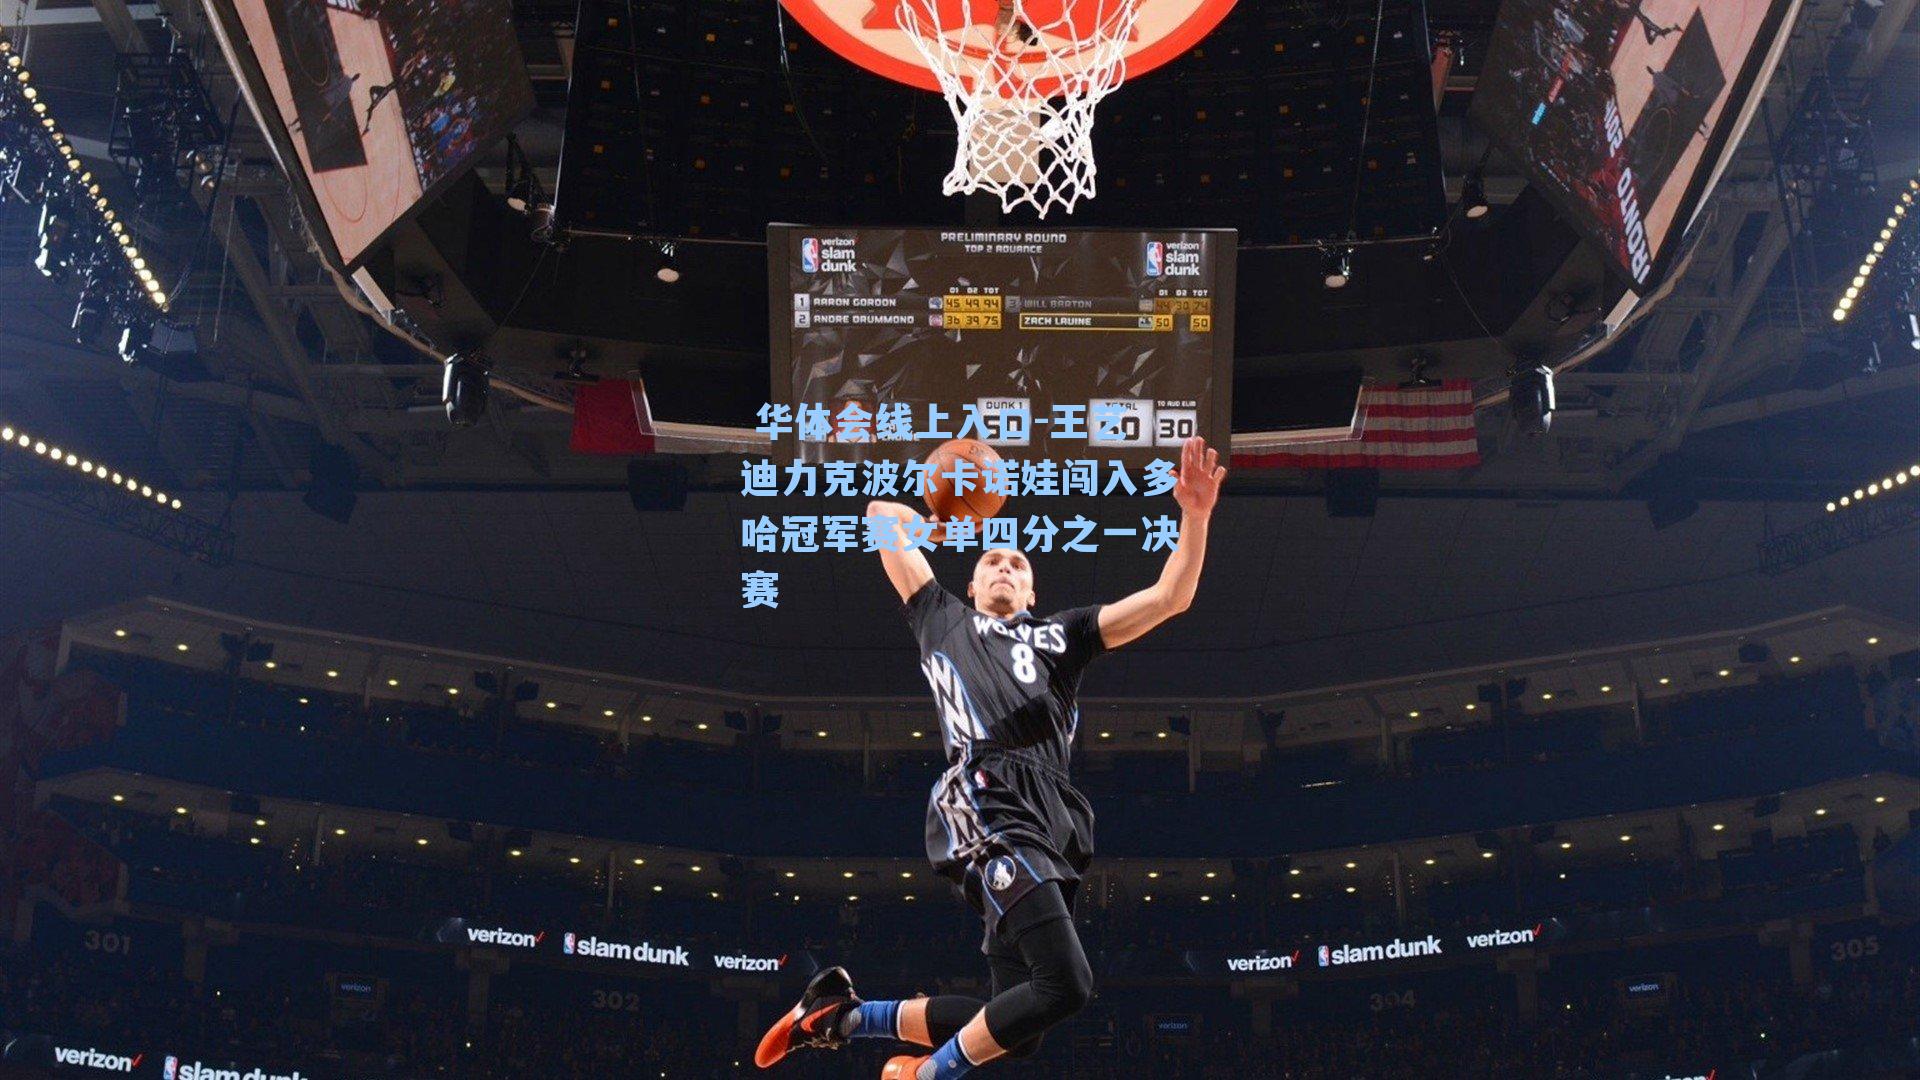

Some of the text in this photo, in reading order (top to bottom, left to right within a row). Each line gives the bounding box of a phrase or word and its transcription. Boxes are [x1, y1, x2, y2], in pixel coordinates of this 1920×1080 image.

[821, 237, 855, 246] verizon
[940, 232, 1067, 243] PRELIMINARY ROUND
[964, 244, 1043, 254] TOP 2 ADVANCE
[1166, 241, 1199, 250] verizon
[821, 246, 856, 260] slam
[1165, 249, 1200, 263] slam
[821, 259, 857, 272] dunk
[1164, 262, 1200, 276] dunk
[813, 298, 850, 307] AARON
[852, 298, 896, 307] GORDON
[946, 300, 960, 308] 45
[965, 299, 979, 308] 49
[983, 300, 999, 308] 94
[1023, 300, 1047, 308] WILL
[813, 315, 849, 324] ANDRE
[852, 315, 915, 324] DRUMMOND
[966, 316, 979, 325] 39
[984, 316, 999, 325] 75
[1024, 317, 1052, 325] ZACH
[1156, 318, 1170, 327] 50
[1193, 318, 1208, 327] 50
[986, 401, 1015, 409] DUNK
[1159, 418, 1193, 438] 30
[1011, 643, 1037, 684] 8
[467, 927, 536, 948] verizon
[1466, 928, 1535, 949] verizon
[576, 936, 690, 967] slam dunk
[1331, 935, 1443, 966] slam dunk
[714, 953, 780, 972] verizon
[1227, 953, 1293, 973] verizon
[54, 1046, 133, 1073] verizon
